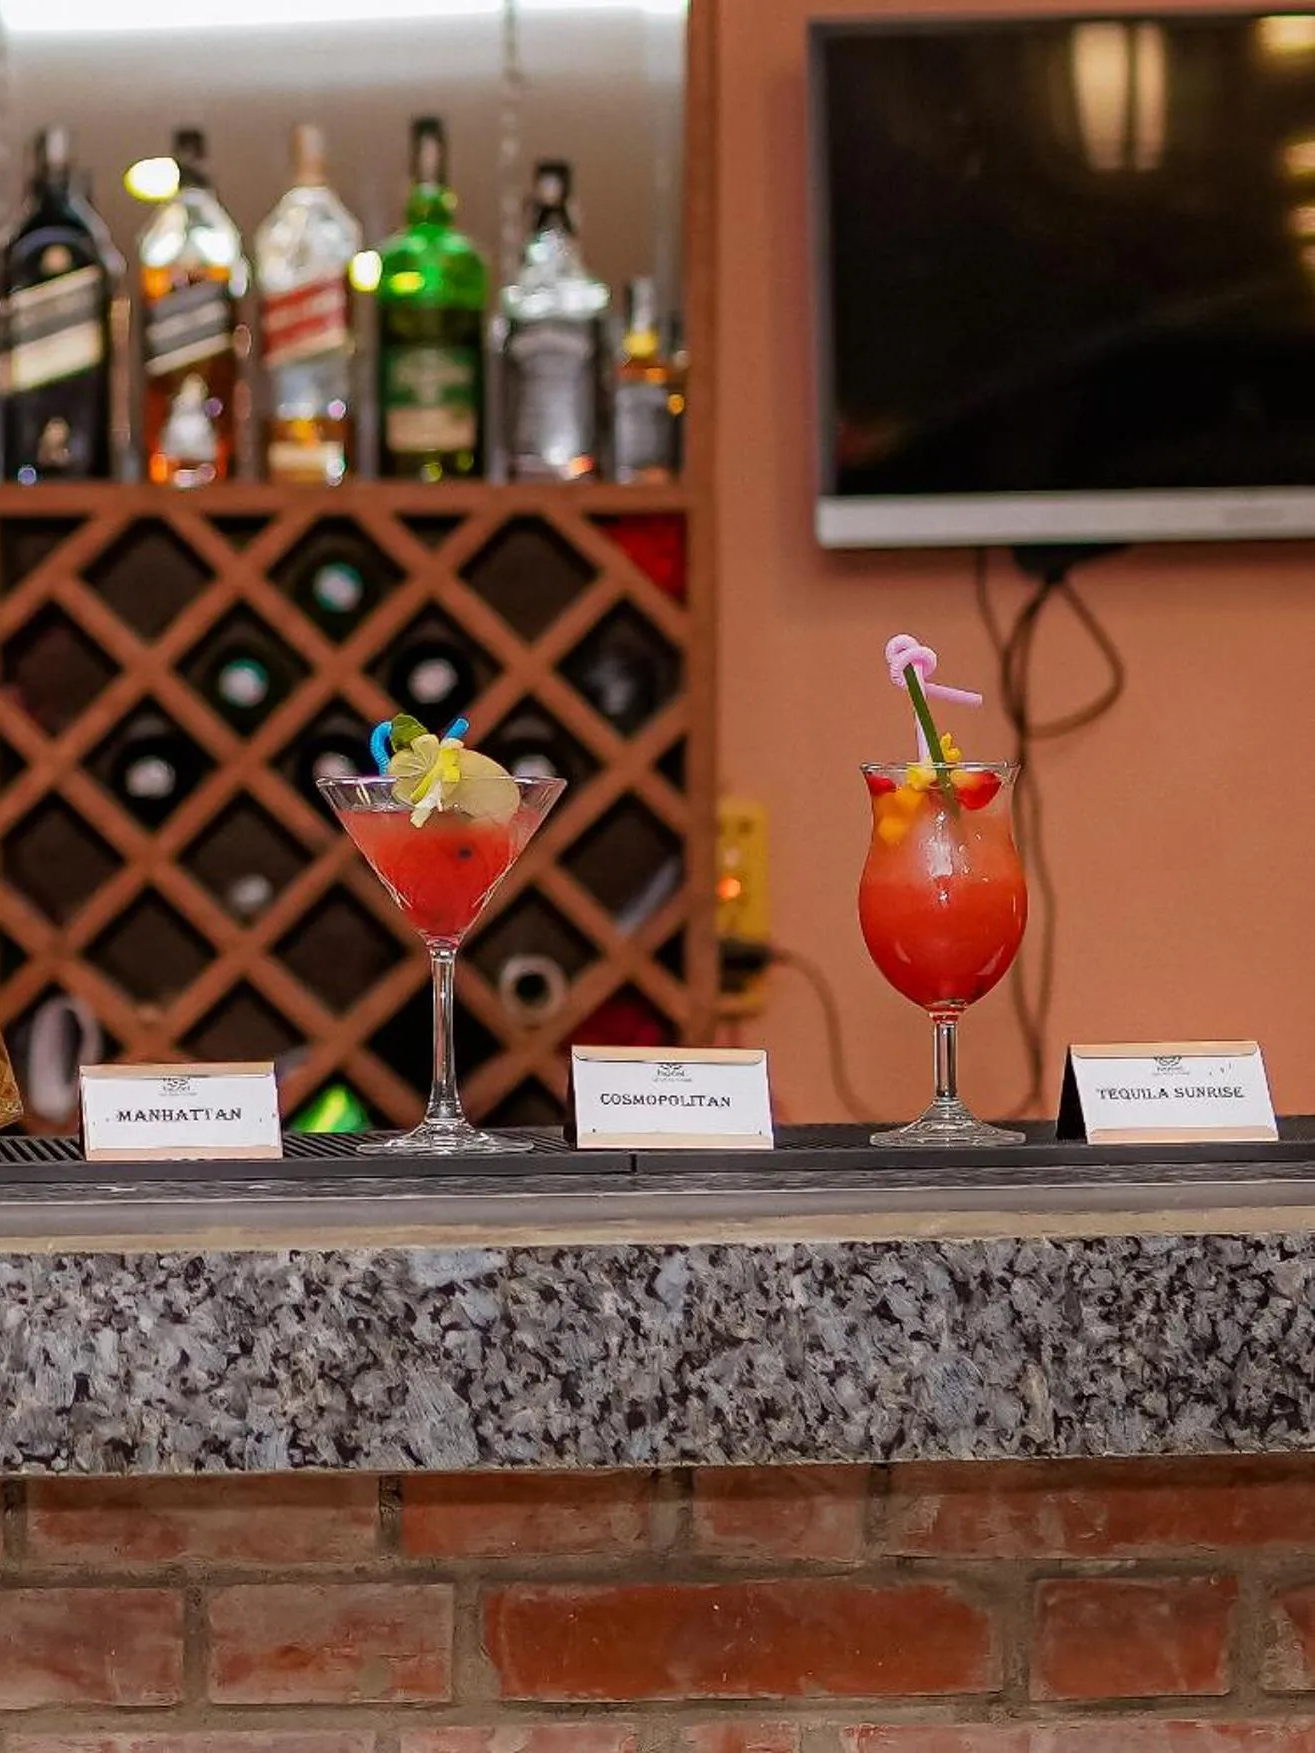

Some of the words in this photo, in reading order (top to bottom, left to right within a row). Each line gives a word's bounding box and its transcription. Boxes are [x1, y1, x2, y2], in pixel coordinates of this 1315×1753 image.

[600, 1092, 731, 1107] COSMOPOLITAN
[1097, 1087, 1169, 1100] TEQUILA
[1174, 1086, 1245, 1099] SUNRISE
[117, 1107, 242, 1122] MANHATTAN
